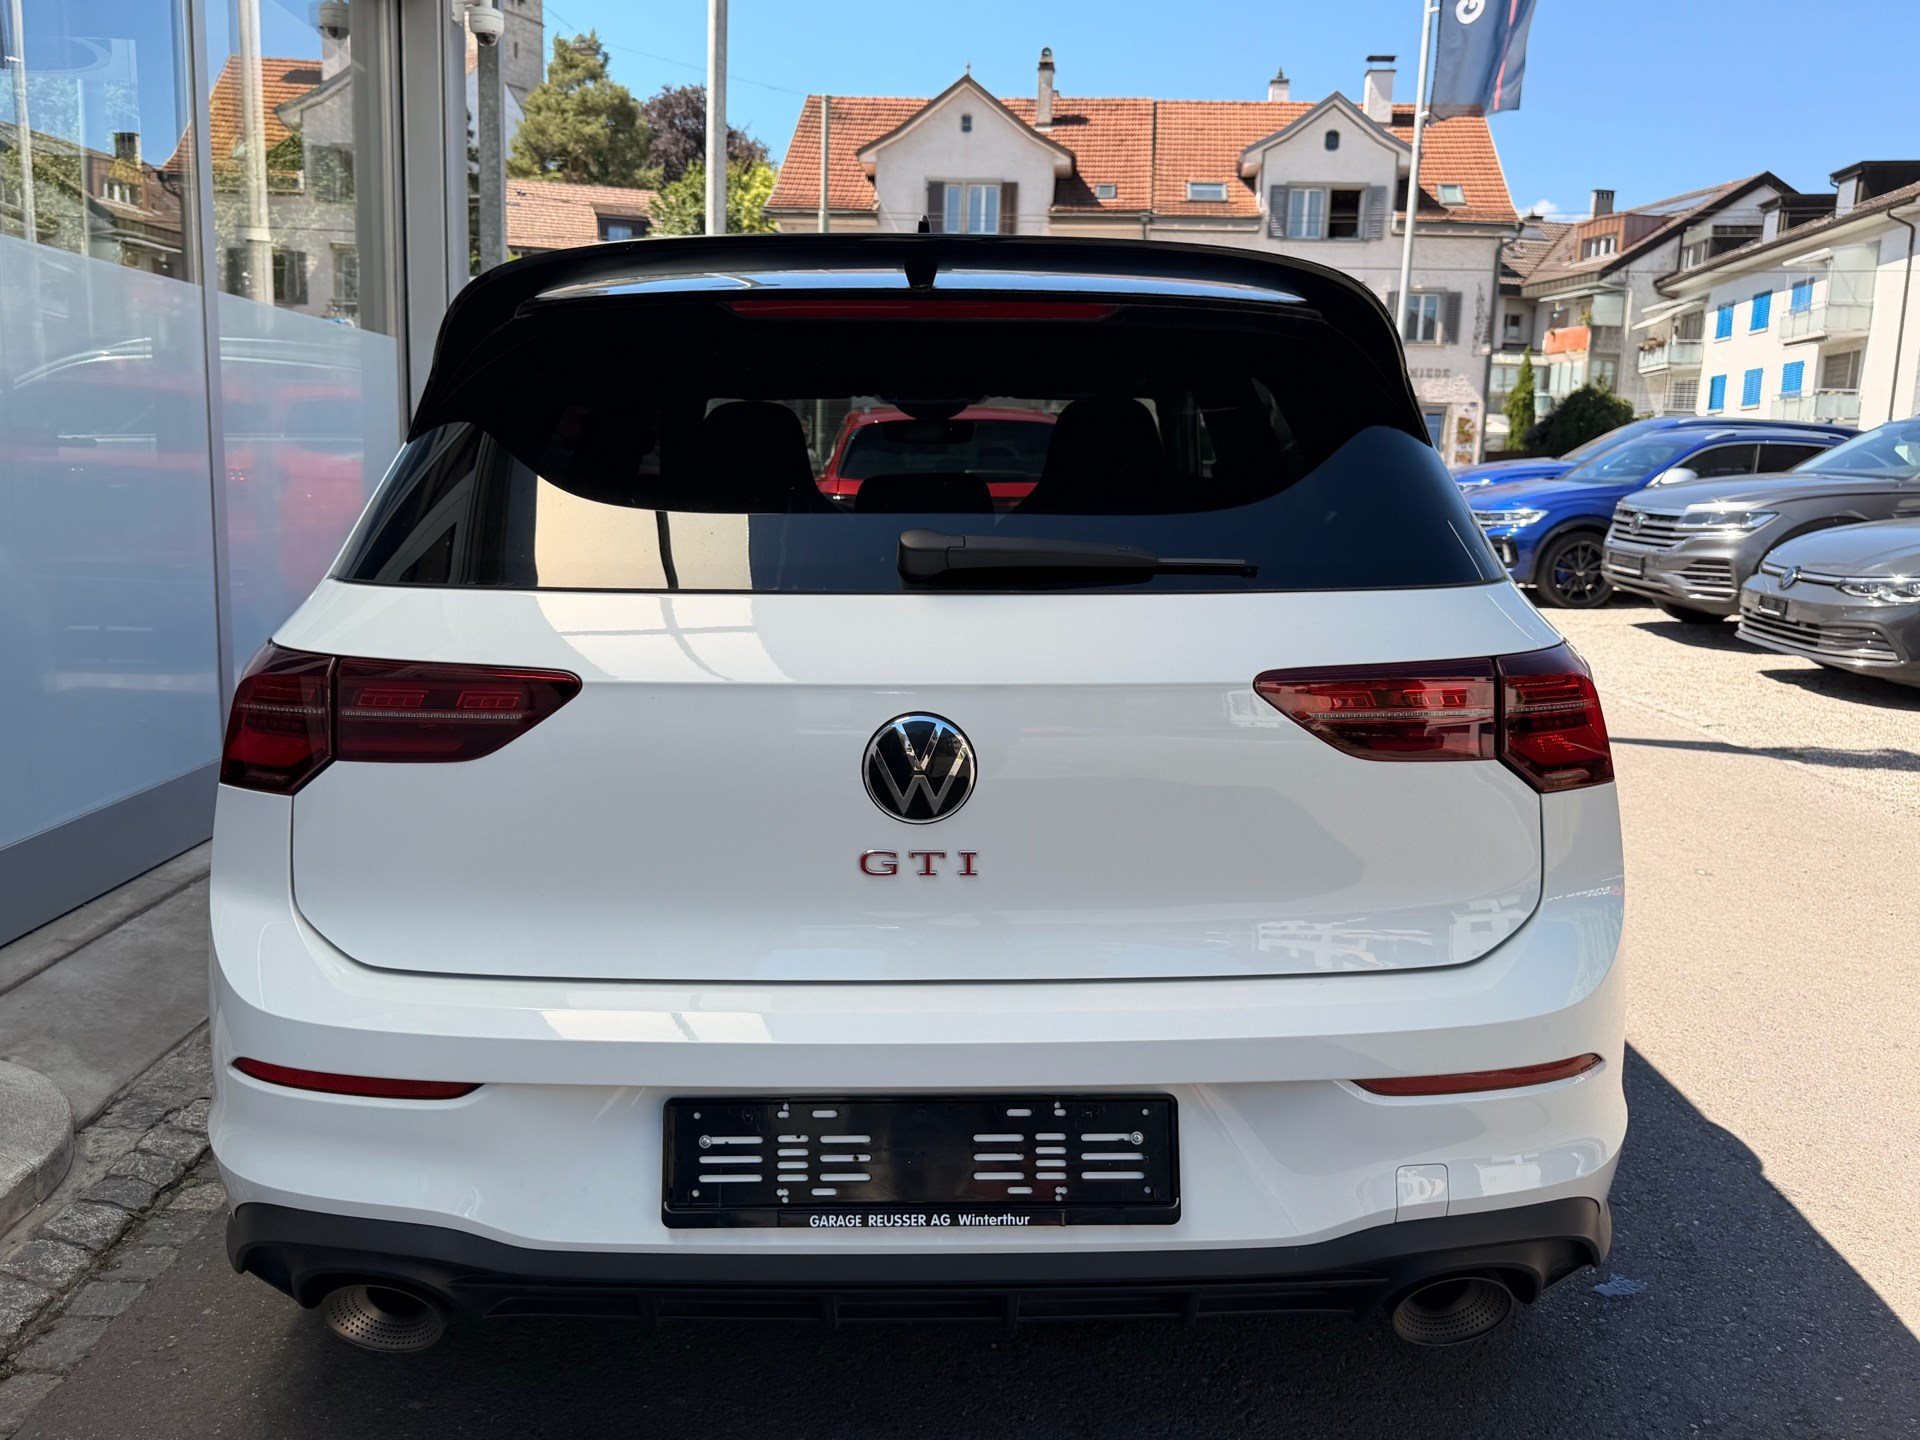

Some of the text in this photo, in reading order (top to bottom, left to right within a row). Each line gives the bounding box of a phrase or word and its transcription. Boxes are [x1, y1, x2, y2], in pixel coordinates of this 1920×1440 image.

[866, 715, 973, 820] VW
[859, 849, 980, 877] GTI
[809, 1213, 1031, 1227] GARAGE REUSSER AG Winterthur
